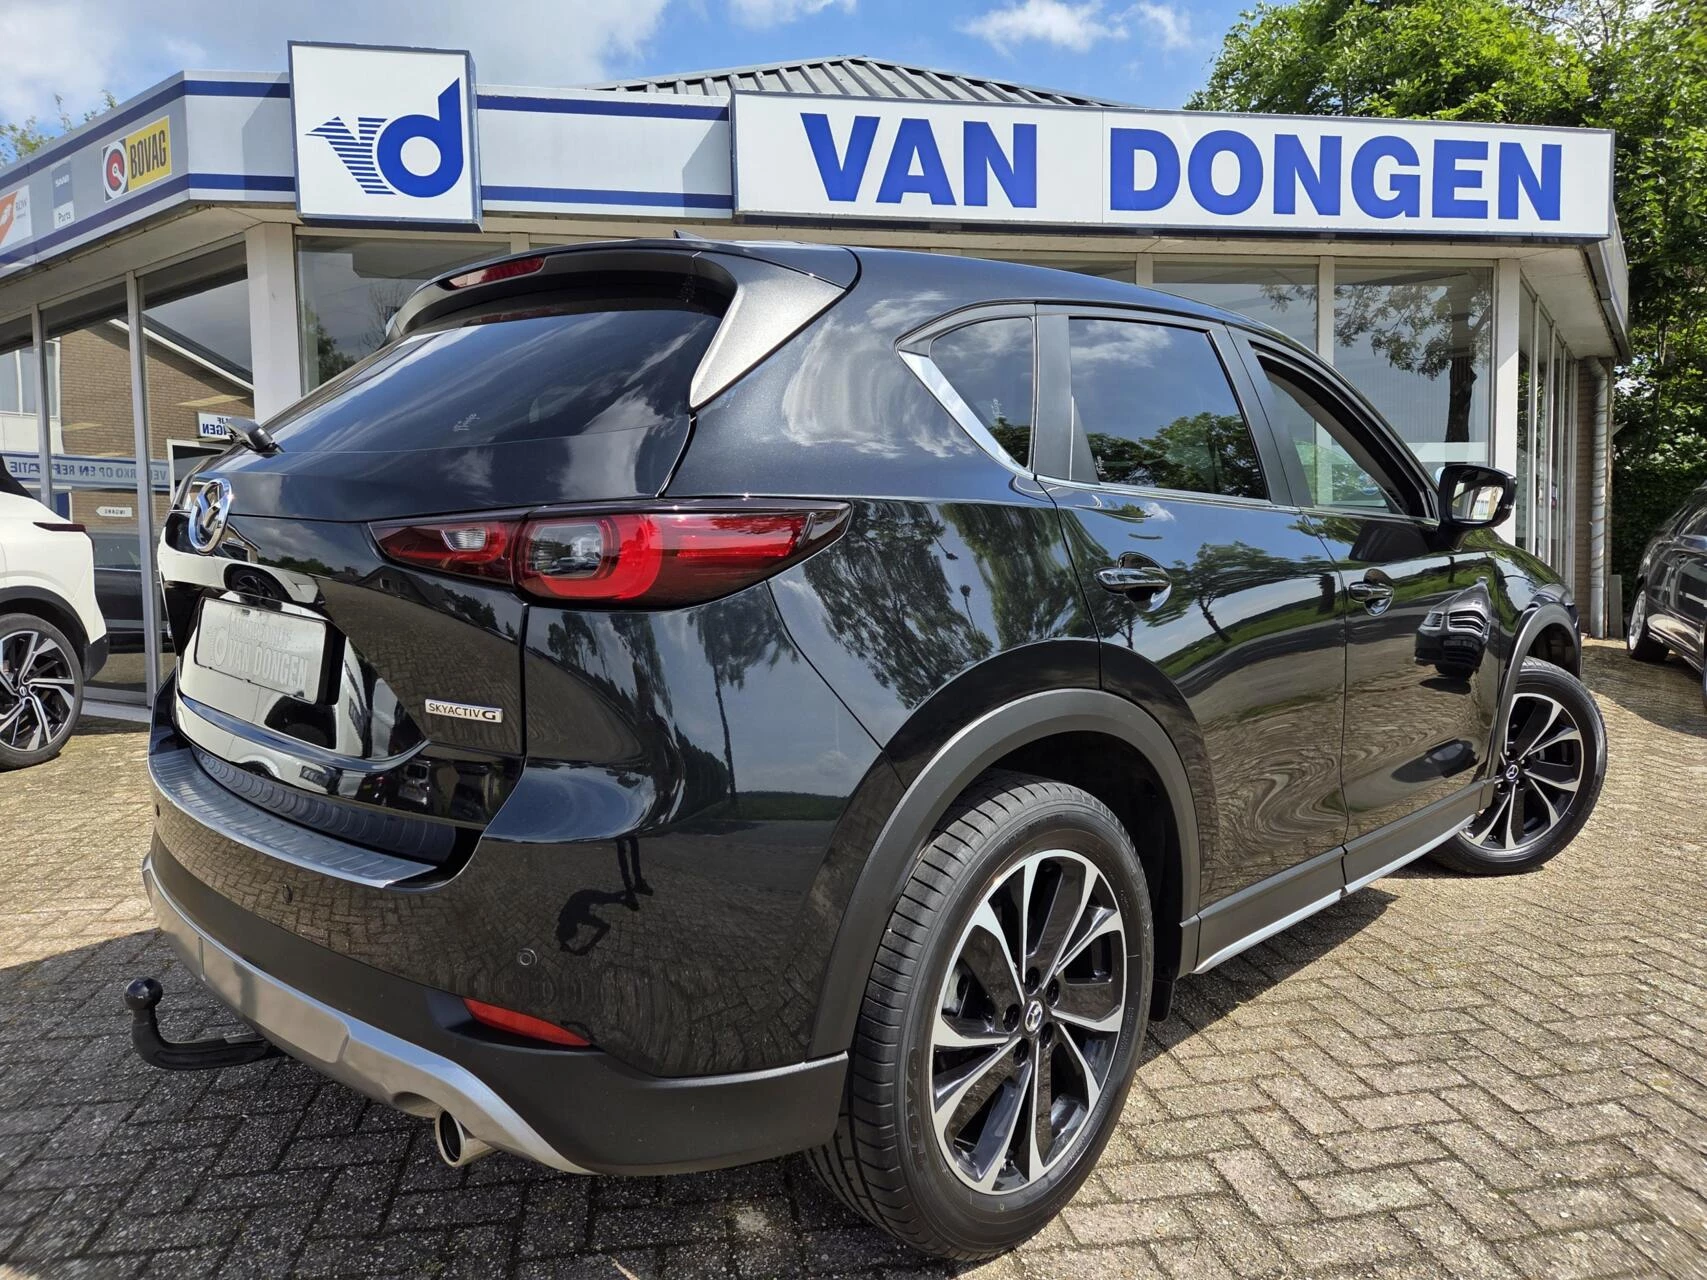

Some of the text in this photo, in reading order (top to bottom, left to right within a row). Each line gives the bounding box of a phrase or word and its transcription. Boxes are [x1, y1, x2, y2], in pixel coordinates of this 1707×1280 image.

[130, 129, 167, 180] BOVAG
[800, 112, 1563, 221] VAN DONGEN
[428, 702, 496, 721] SKYACTIV G
